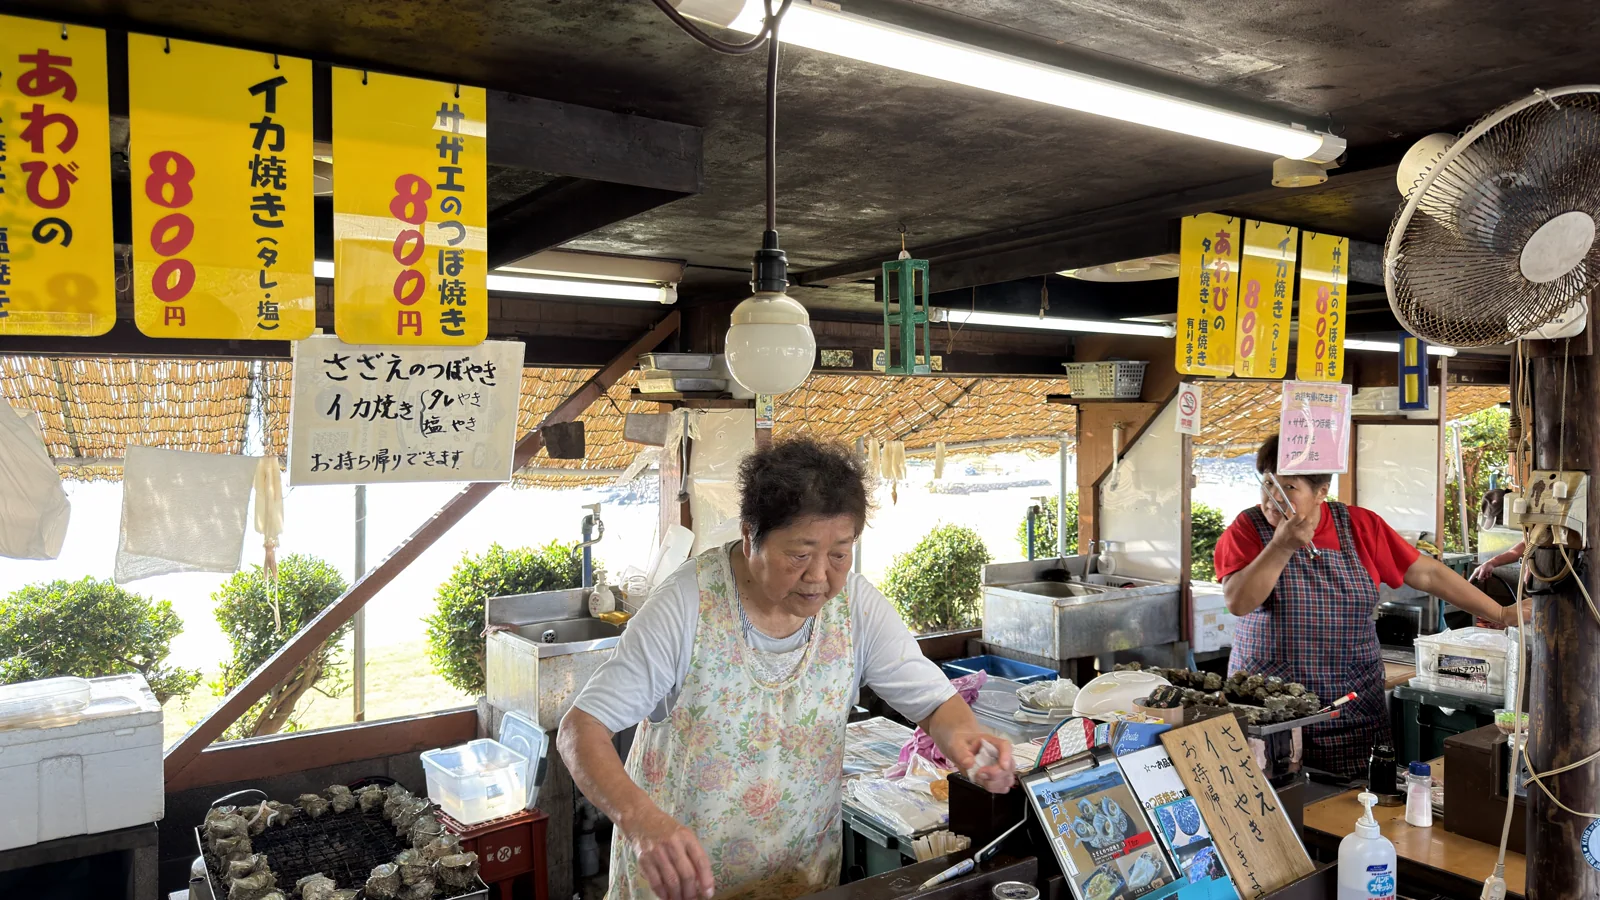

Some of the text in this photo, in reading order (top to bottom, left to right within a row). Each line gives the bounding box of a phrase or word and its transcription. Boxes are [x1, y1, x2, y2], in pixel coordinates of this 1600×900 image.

[16, 48, 80, 248] あわびの
[145, 150, 196, 328] 800円
[389, 173, 433, 337] 800円
[435, 102, 467, 337] サザエのつぼ焼き
[1212, 229, 1232, 332] あわびの
[1240, 279, 1261, 372] 800円
[323, 352, 497, 387] さざえのつぼやき
[1185, 317, 1195, 368] 有ります
[1314, 285, 1330, 377] 800円
[326, 393, 414, 422] イカ焼き
[310, 448, 465, 474] お持ち帰りできます
[1204, 731, 1265, 843] イカやき
[1220, 725, 1276, 817] さざえ
